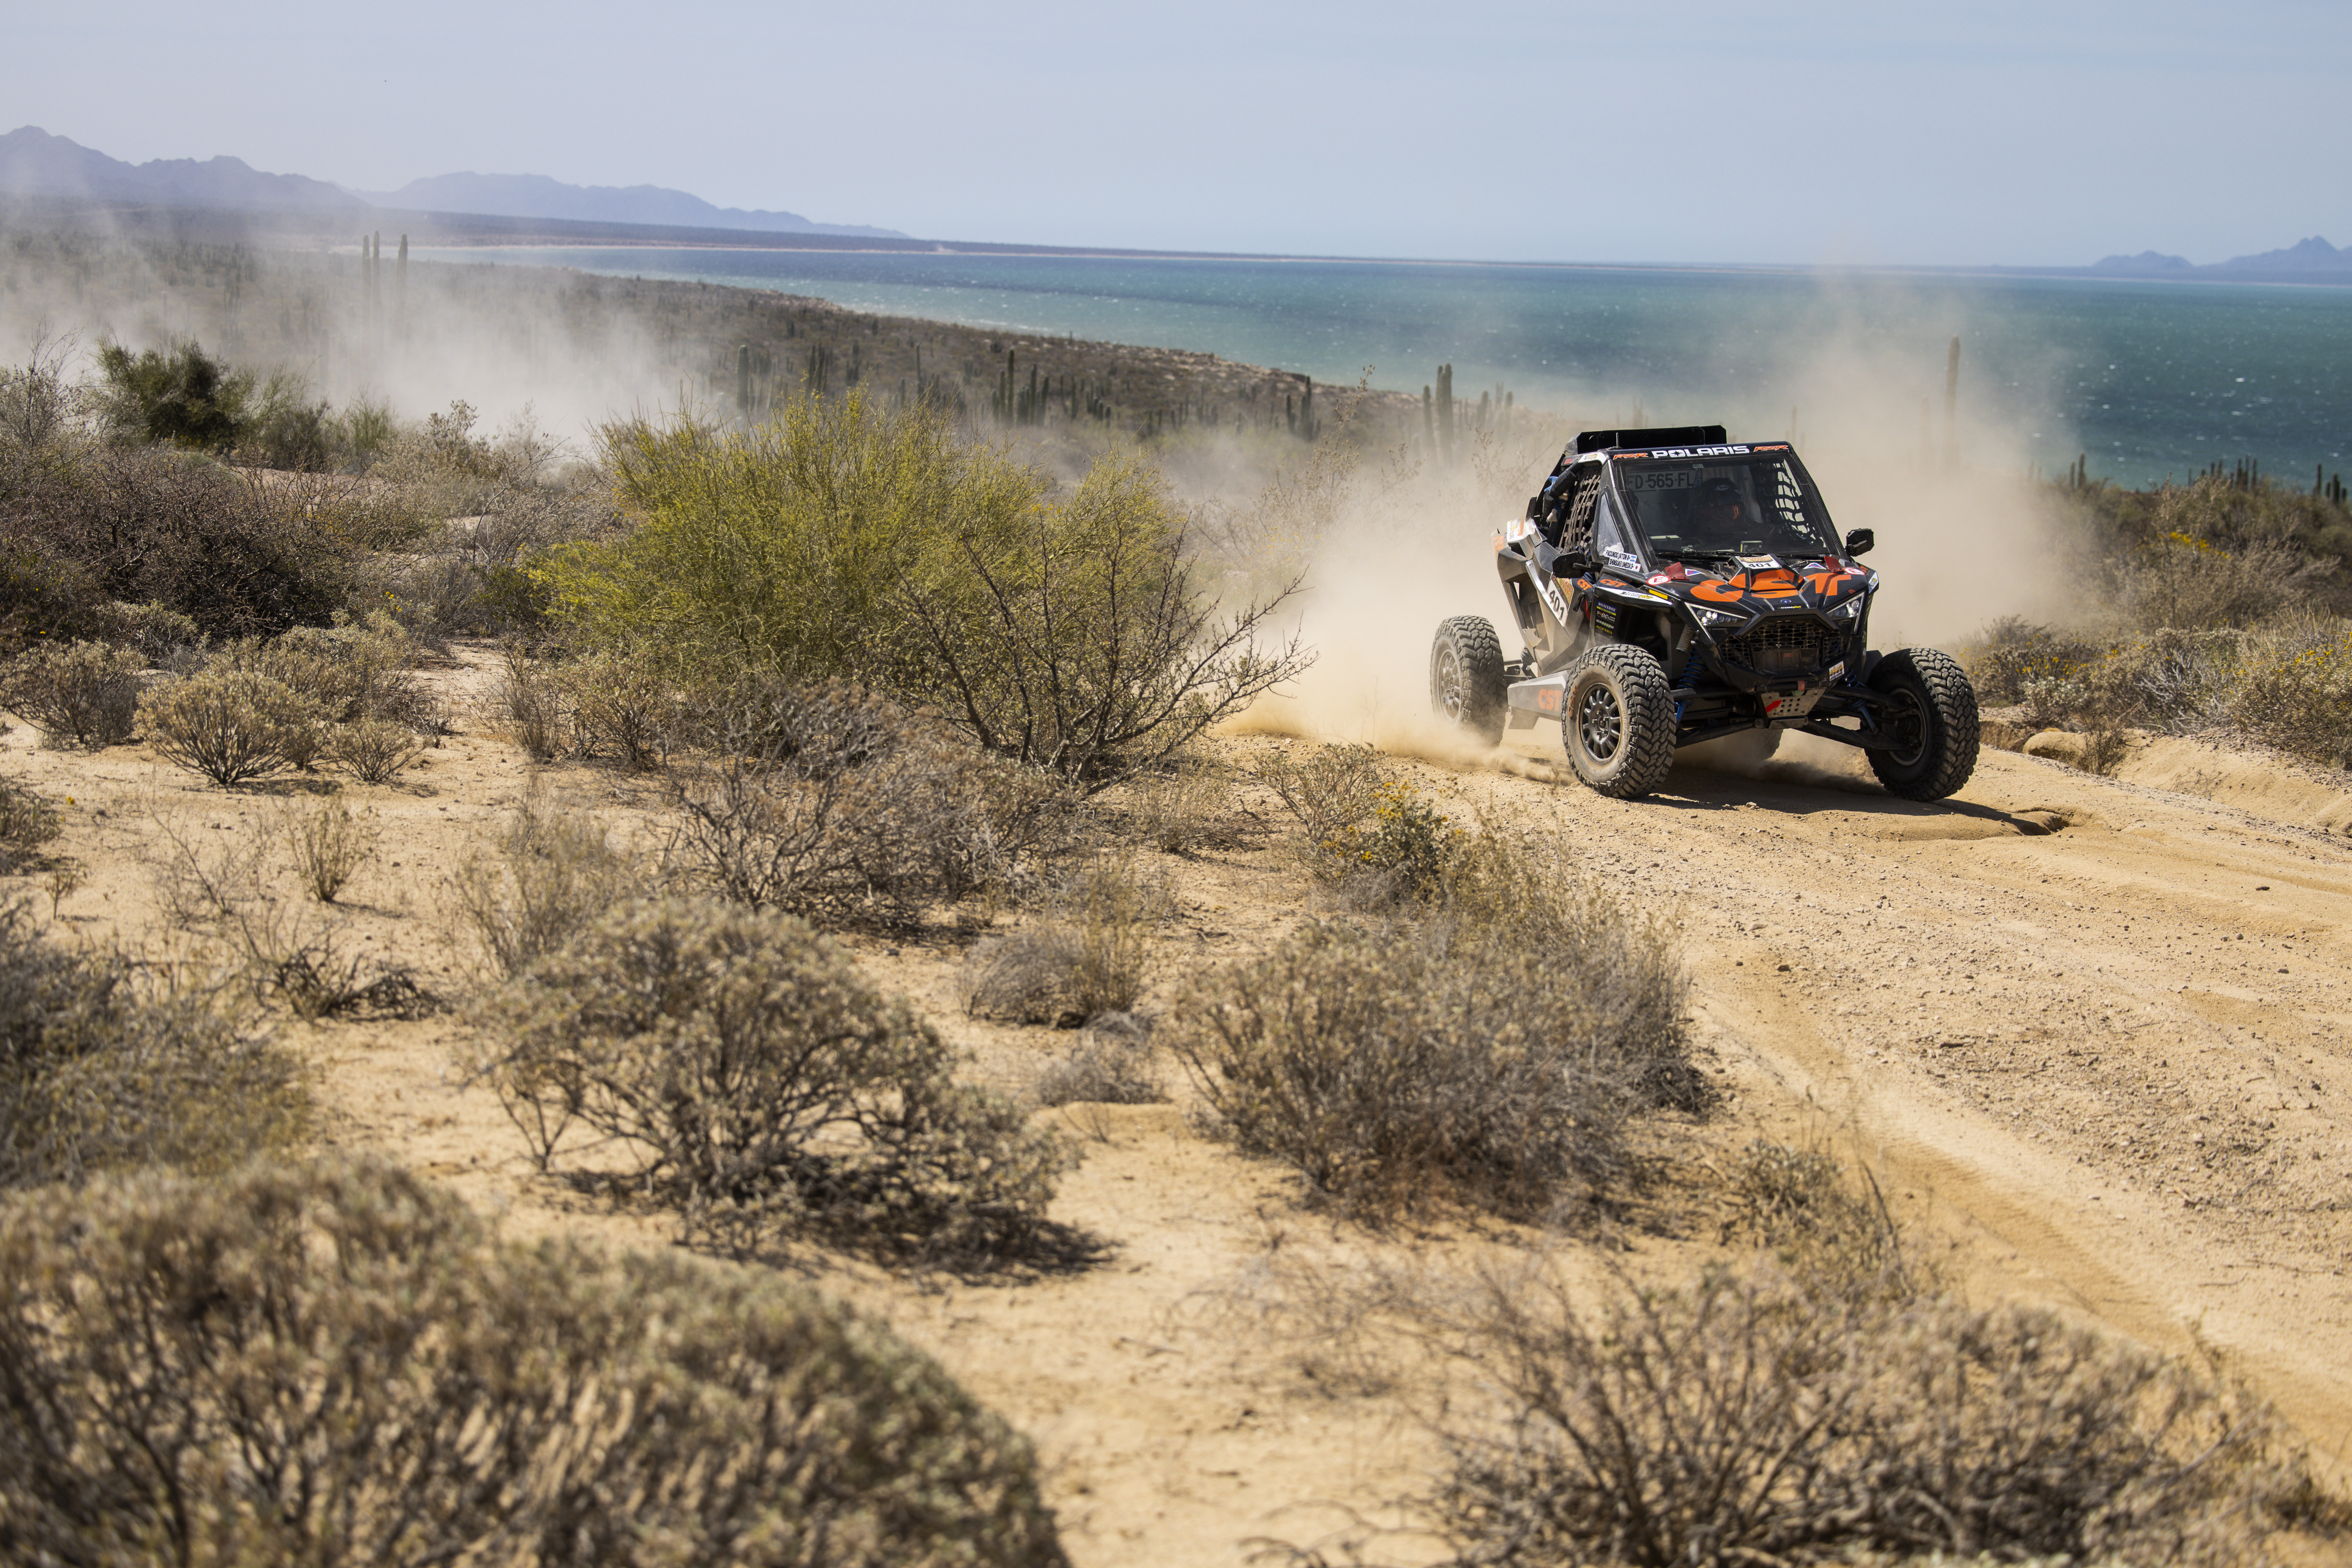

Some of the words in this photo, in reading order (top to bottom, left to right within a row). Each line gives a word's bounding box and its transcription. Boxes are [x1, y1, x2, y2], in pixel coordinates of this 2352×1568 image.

[1651, 445, 1750, 459] POLARIS
[1577, 579, 1592, 590] CST
[1600, 579, 1627, 587] CST
[1690, 568, 1851, 602] CST
[1549, 590, 1565, 621] 401
[1538, 688, 1562, 711] CST
[1568, 685, 1578, 717] CST
